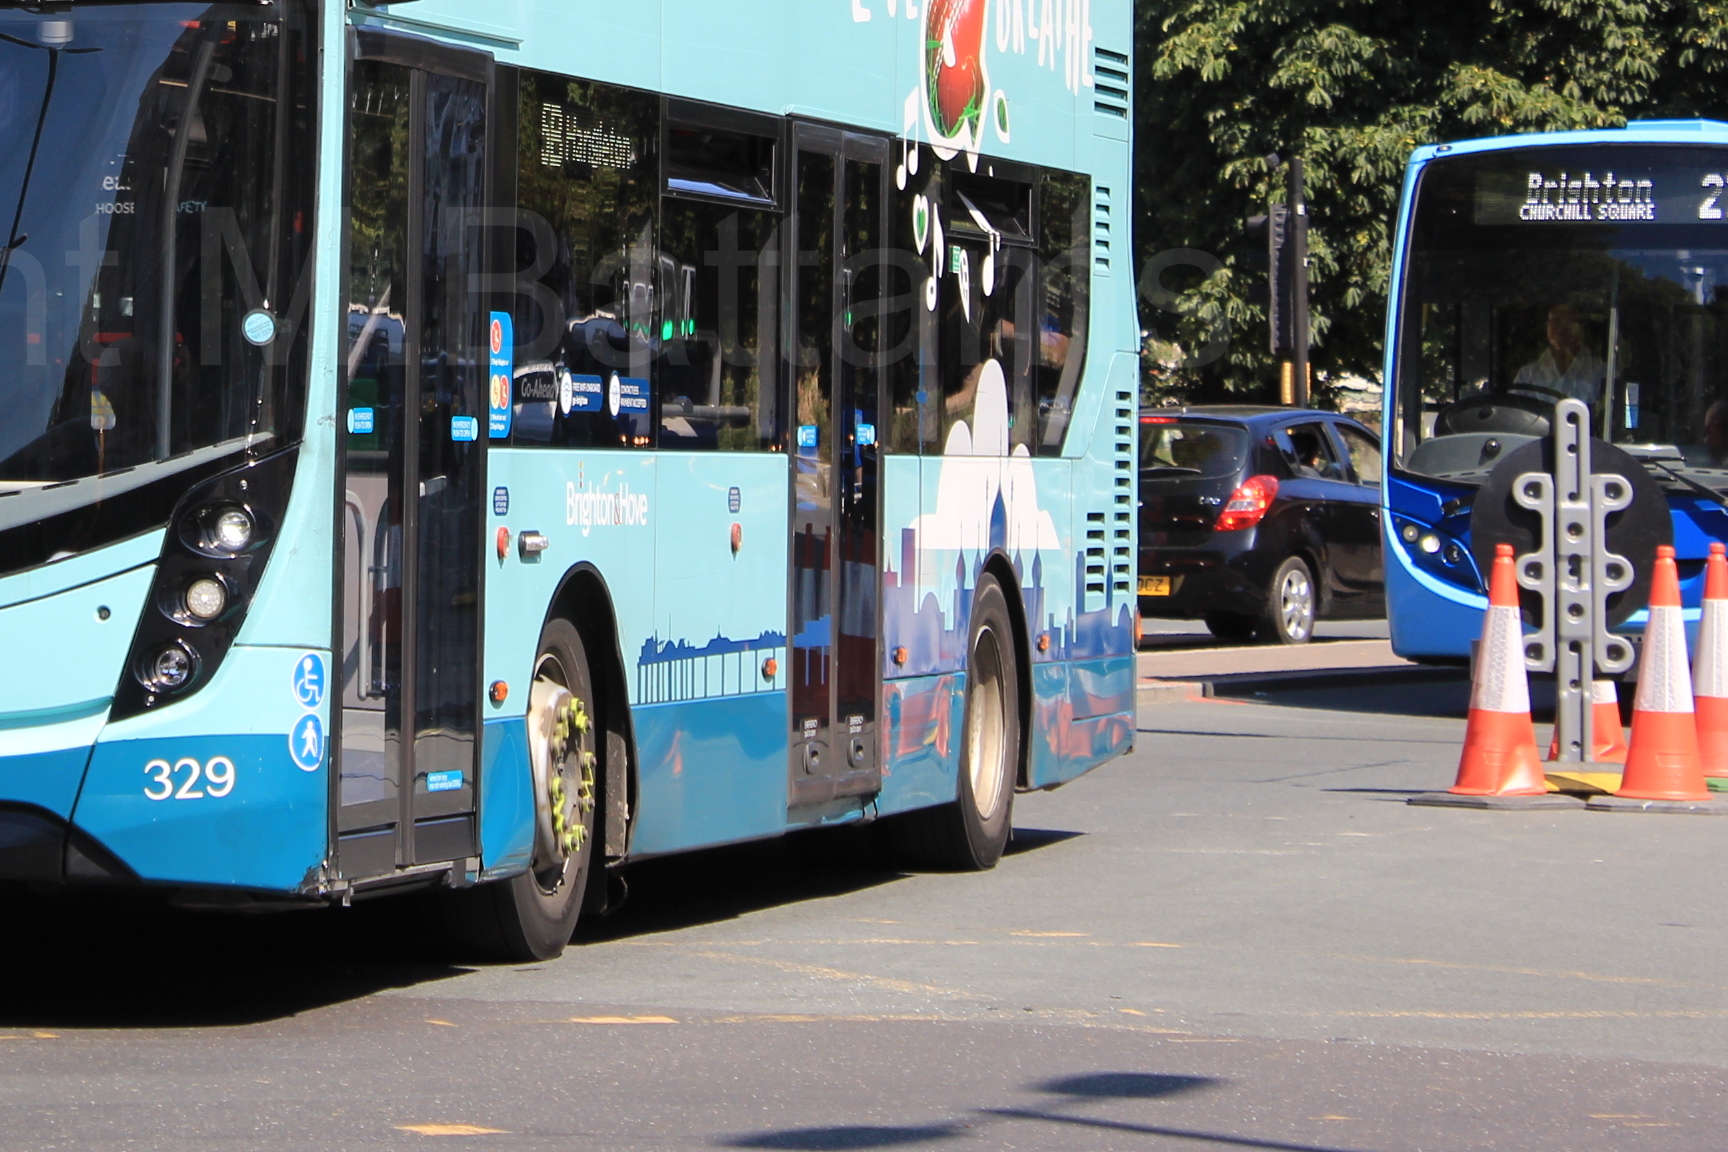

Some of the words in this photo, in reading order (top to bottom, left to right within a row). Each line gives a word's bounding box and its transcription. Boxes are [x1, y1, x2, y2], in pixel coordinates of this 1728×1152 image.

[566, 115, 631, 169] Hangleton
[1519, 203, 1592, 220] CHURCHILL
[1597, 203, 1655, 220] SQUARE
[1526, 171, 1653, 204] Brighton
[1698, 173, 1728, 220] 2
[521, 377, 556, 399] Go-Ahead
[144, 756, 236, 801] 329
